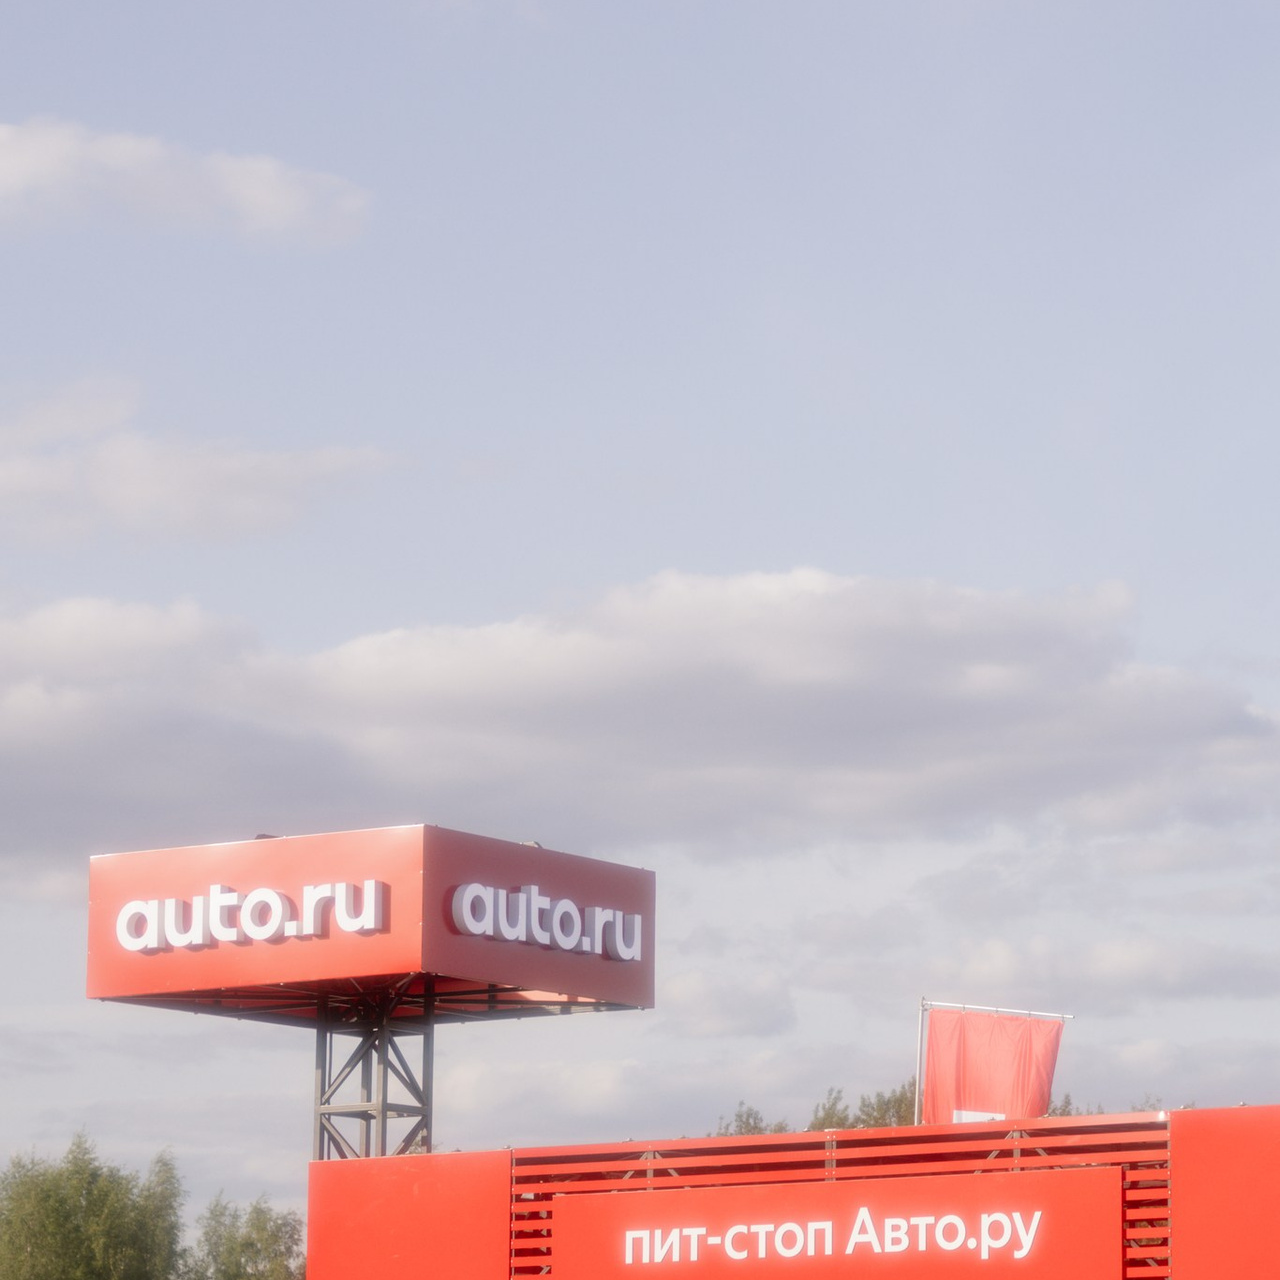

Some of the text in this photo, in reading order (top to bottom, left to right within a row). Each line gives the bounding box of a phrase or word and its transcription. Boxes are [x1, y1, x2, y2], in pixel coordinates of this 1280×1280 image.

[115, 879, 381, 953] auto.ru
[455, 882, 642, 962] auto.ru
[625, 1207, 1042, 1264] пит-стоп Авто.ру
